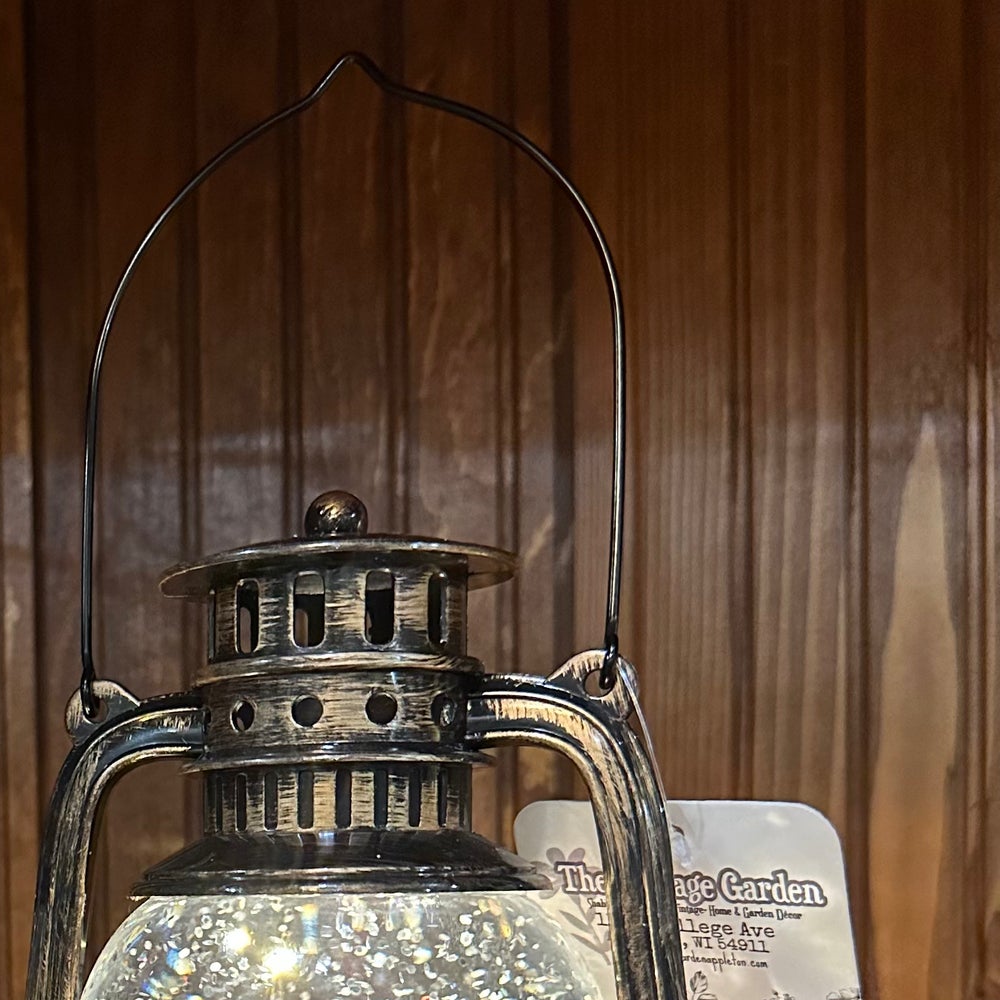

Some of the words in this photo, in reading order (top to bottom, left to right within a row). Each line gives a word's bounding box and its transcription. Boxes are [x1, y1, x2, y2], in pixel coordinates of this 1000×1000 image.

[555, 861, 606, 895] The
[717, 868, 828, 907] Garden
[709, 904, 732, 917] Home
[742, 906, 774, 919] Garden
[678, 918, 733, 938] llege
[739, 921, 776, 938] Ave
[691, 936, 713, 949] WI
[717, 937, 770, 953] 54911
